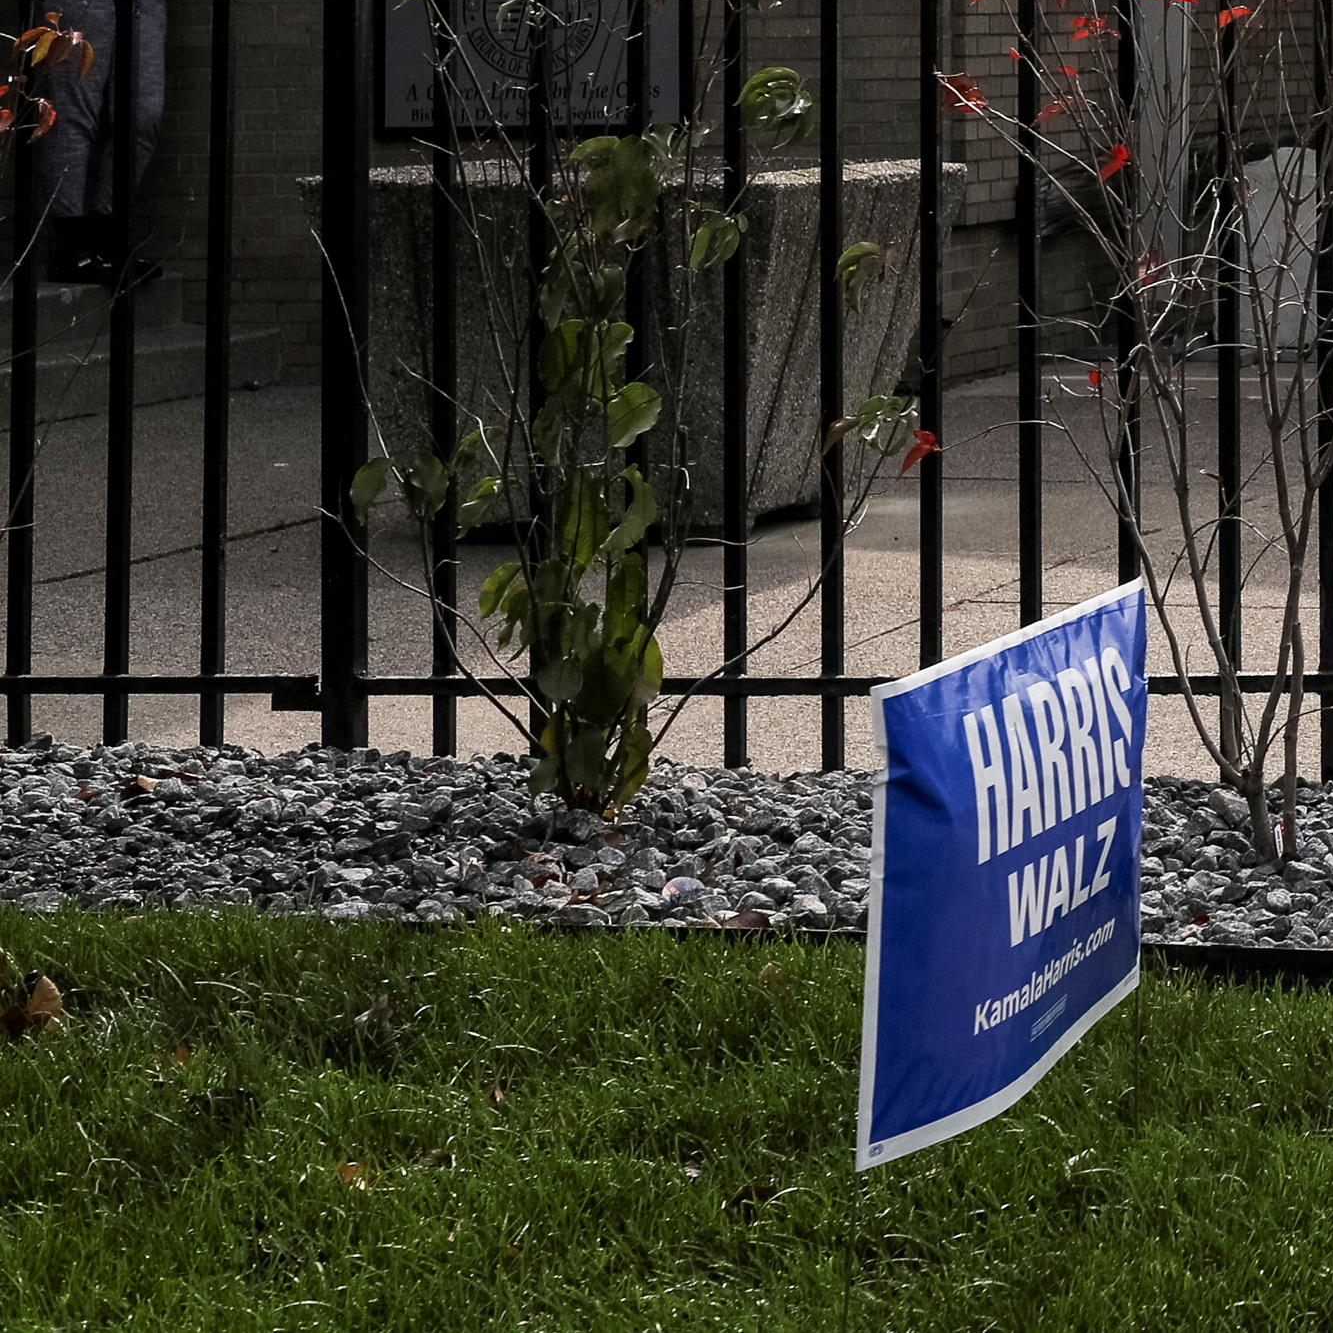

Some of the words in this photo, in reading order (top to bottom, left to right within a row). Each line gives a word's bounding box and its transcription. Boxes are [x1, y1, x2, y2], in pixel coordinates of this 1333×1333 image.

[406, 82, 417, 101] A
[471, 28, 505, 68] CHURCH
[508, 57, 523, 74] OF
[963, 646, 1132, 865] HARRIS
[1008, 816, 1117, 948] WALZ
[974, 918, 1116, 1036] KamalaHarris.com
